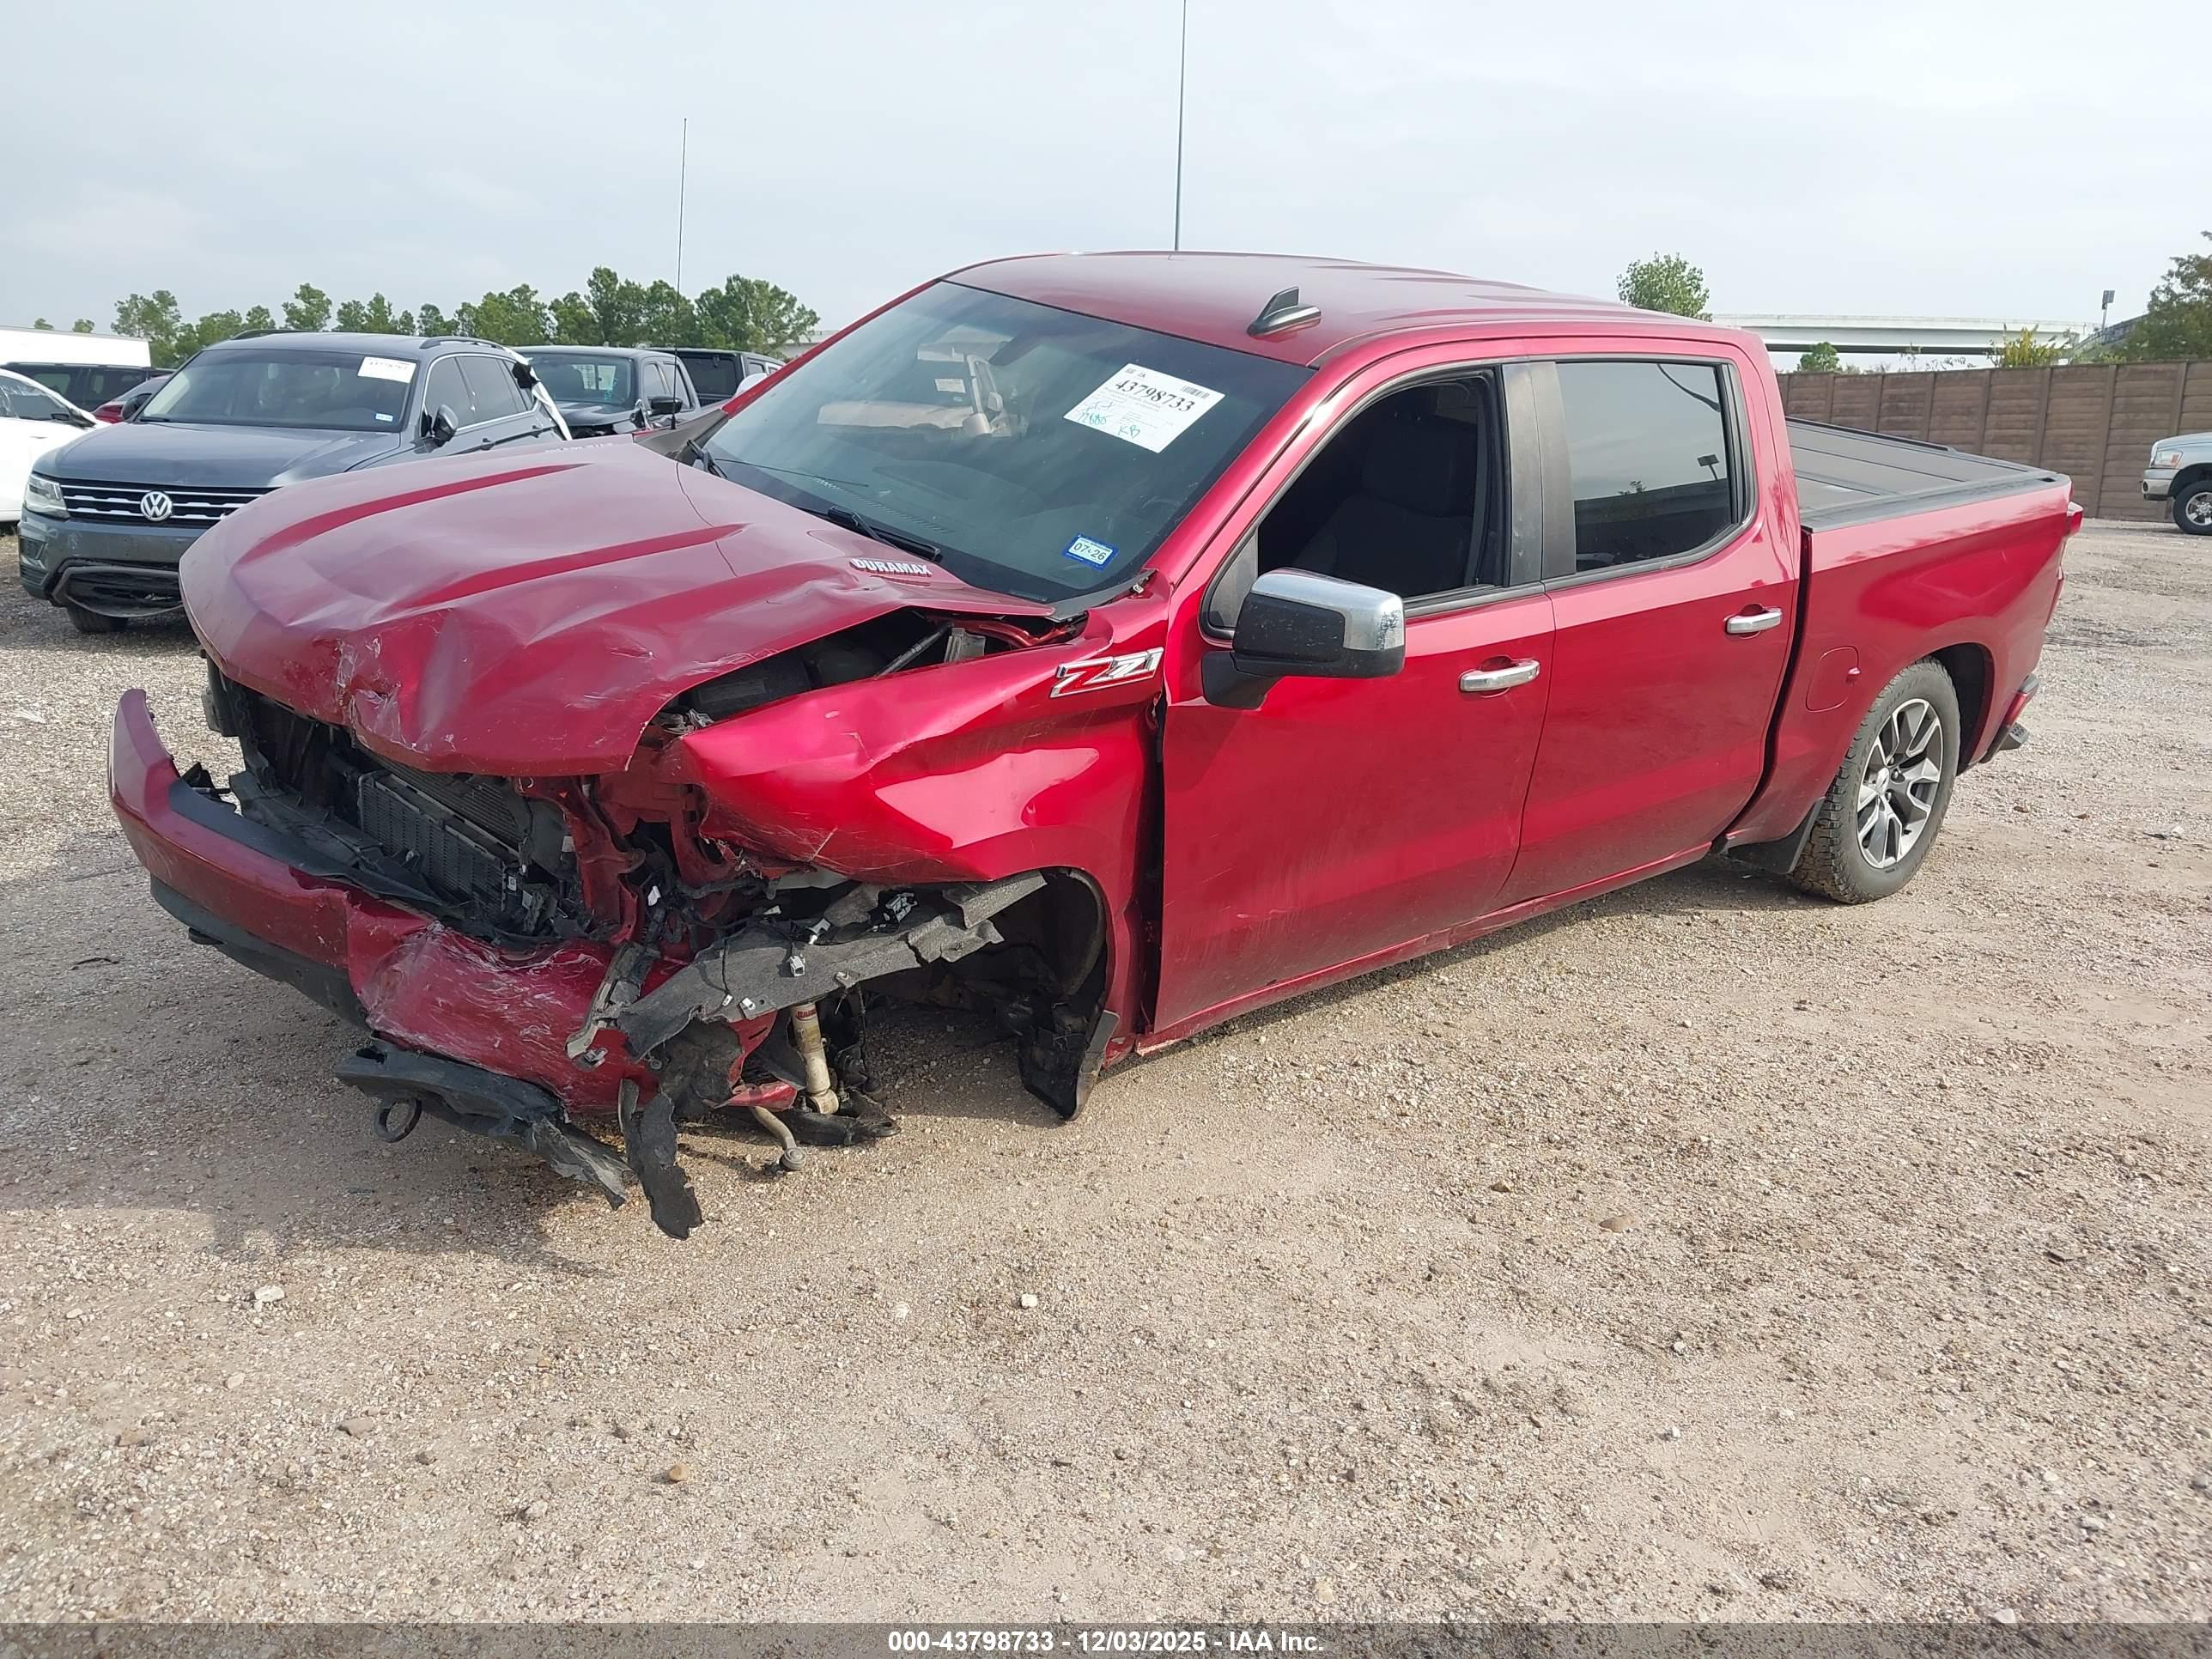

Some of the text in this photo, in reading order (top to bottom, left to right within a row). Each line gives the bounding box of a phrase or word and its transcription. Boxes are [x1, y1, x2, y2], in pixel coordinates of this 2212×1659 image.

[1115, 380, 1195, 412] 43798733
[1073, 543, 1091, 553] 07
[1090, 549, 1107, 561] 26
[849, 556, 933, 577] DURAMAX
[1049, 647, 1164, 699] Z71
